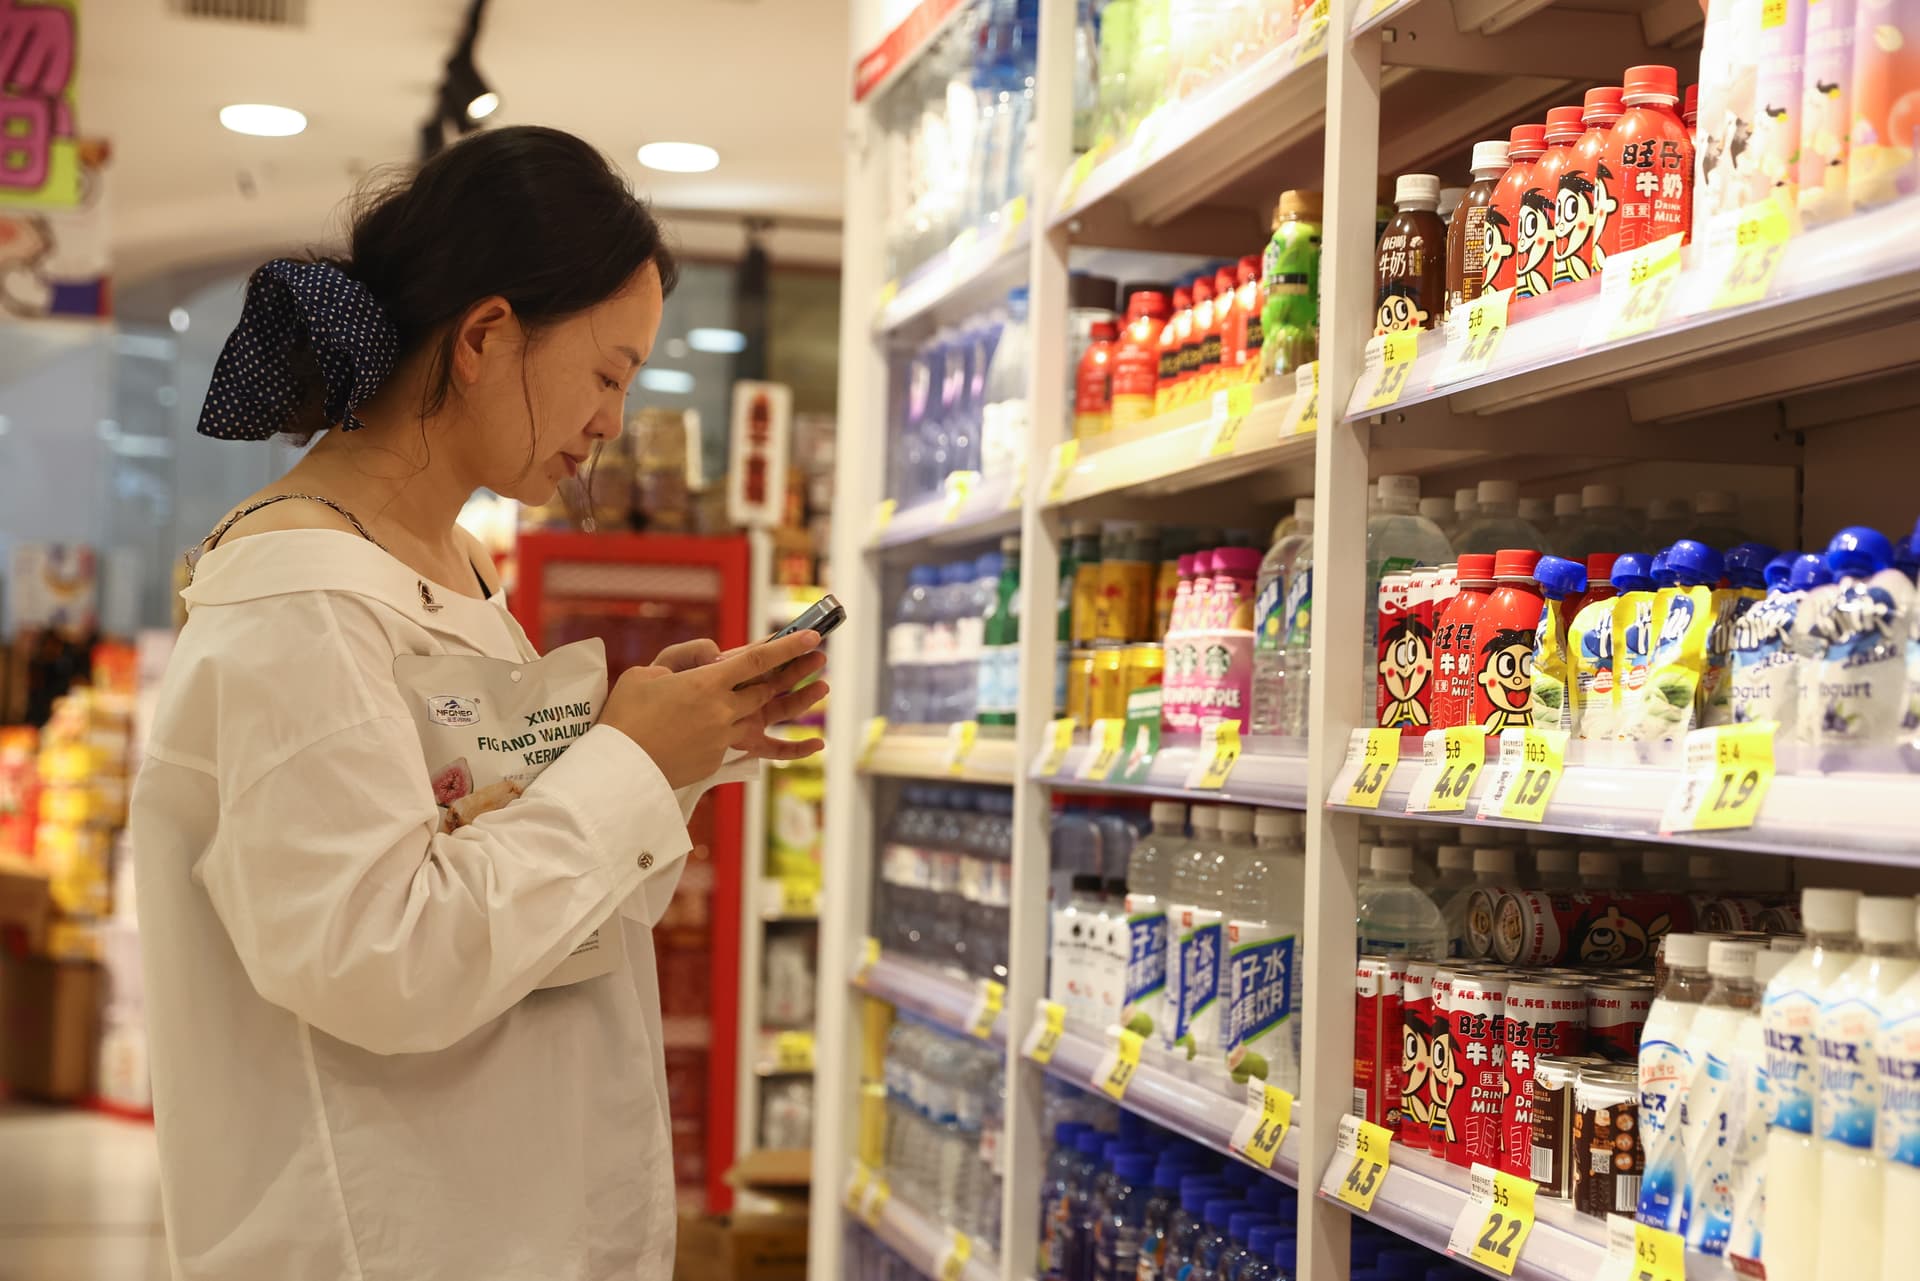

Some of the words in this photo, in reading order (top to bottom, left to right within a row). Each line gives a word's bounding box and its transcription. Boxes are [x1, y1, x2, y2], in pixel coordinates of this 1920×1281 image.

[1635, 171, 1683, 199] 牛奶
[1654, 211, 1681, 223] MILK
[1379, 251, 1406, 279] 牛奶
[1440, 653, 1470, 676] 牛奶
[524, 701, 591, 727] XINJIANG
[477, 737, 499, 752] FIG
[501, 733, 536, 752] AND
[538, 721, 592, 743] WALNUT
[1445, 740, 1461, 759] 5.8
[1525, 743, 1546, 763] 10.5
[1353, 763, 1390, 794] 4.5
[1434, 763, 1476, 798] 4.6
[1514, 769, 1552, 805] 1.9
[1712, 770, 1759, 811] 1.9
[1507, 1020, 1559, 1048] 旺仔
[1471, 1100, 1504, 1114] MIL
[1254, 1118, 1282, 1153] 4.9
[1346, 1158, 1382, 1195] 4.5
[1493, 1184, 1509, 1207] 3.5
[1478, 1213, 1523, 1258] 2.2
